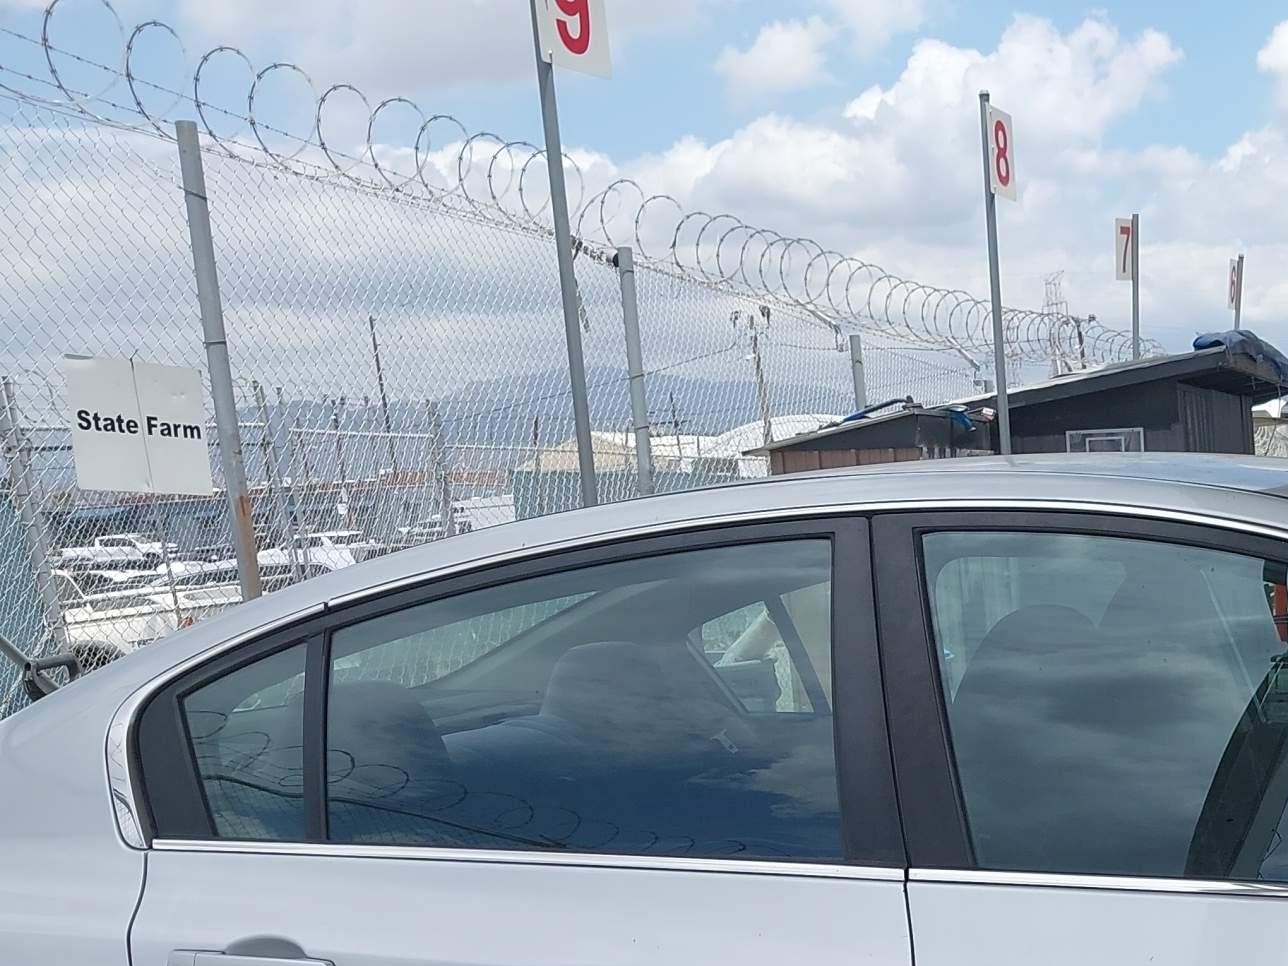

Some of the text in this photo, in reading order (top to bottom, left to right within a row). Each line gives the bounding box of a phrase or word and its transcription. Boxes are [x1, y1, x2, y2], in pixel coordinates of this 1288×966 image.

[994, 119, 1010, 187] 8
[1119, 225, 1131, 273] 7
[1231, 265, 1236, 304] 6
[77, 409, 202, 440] State Farm
